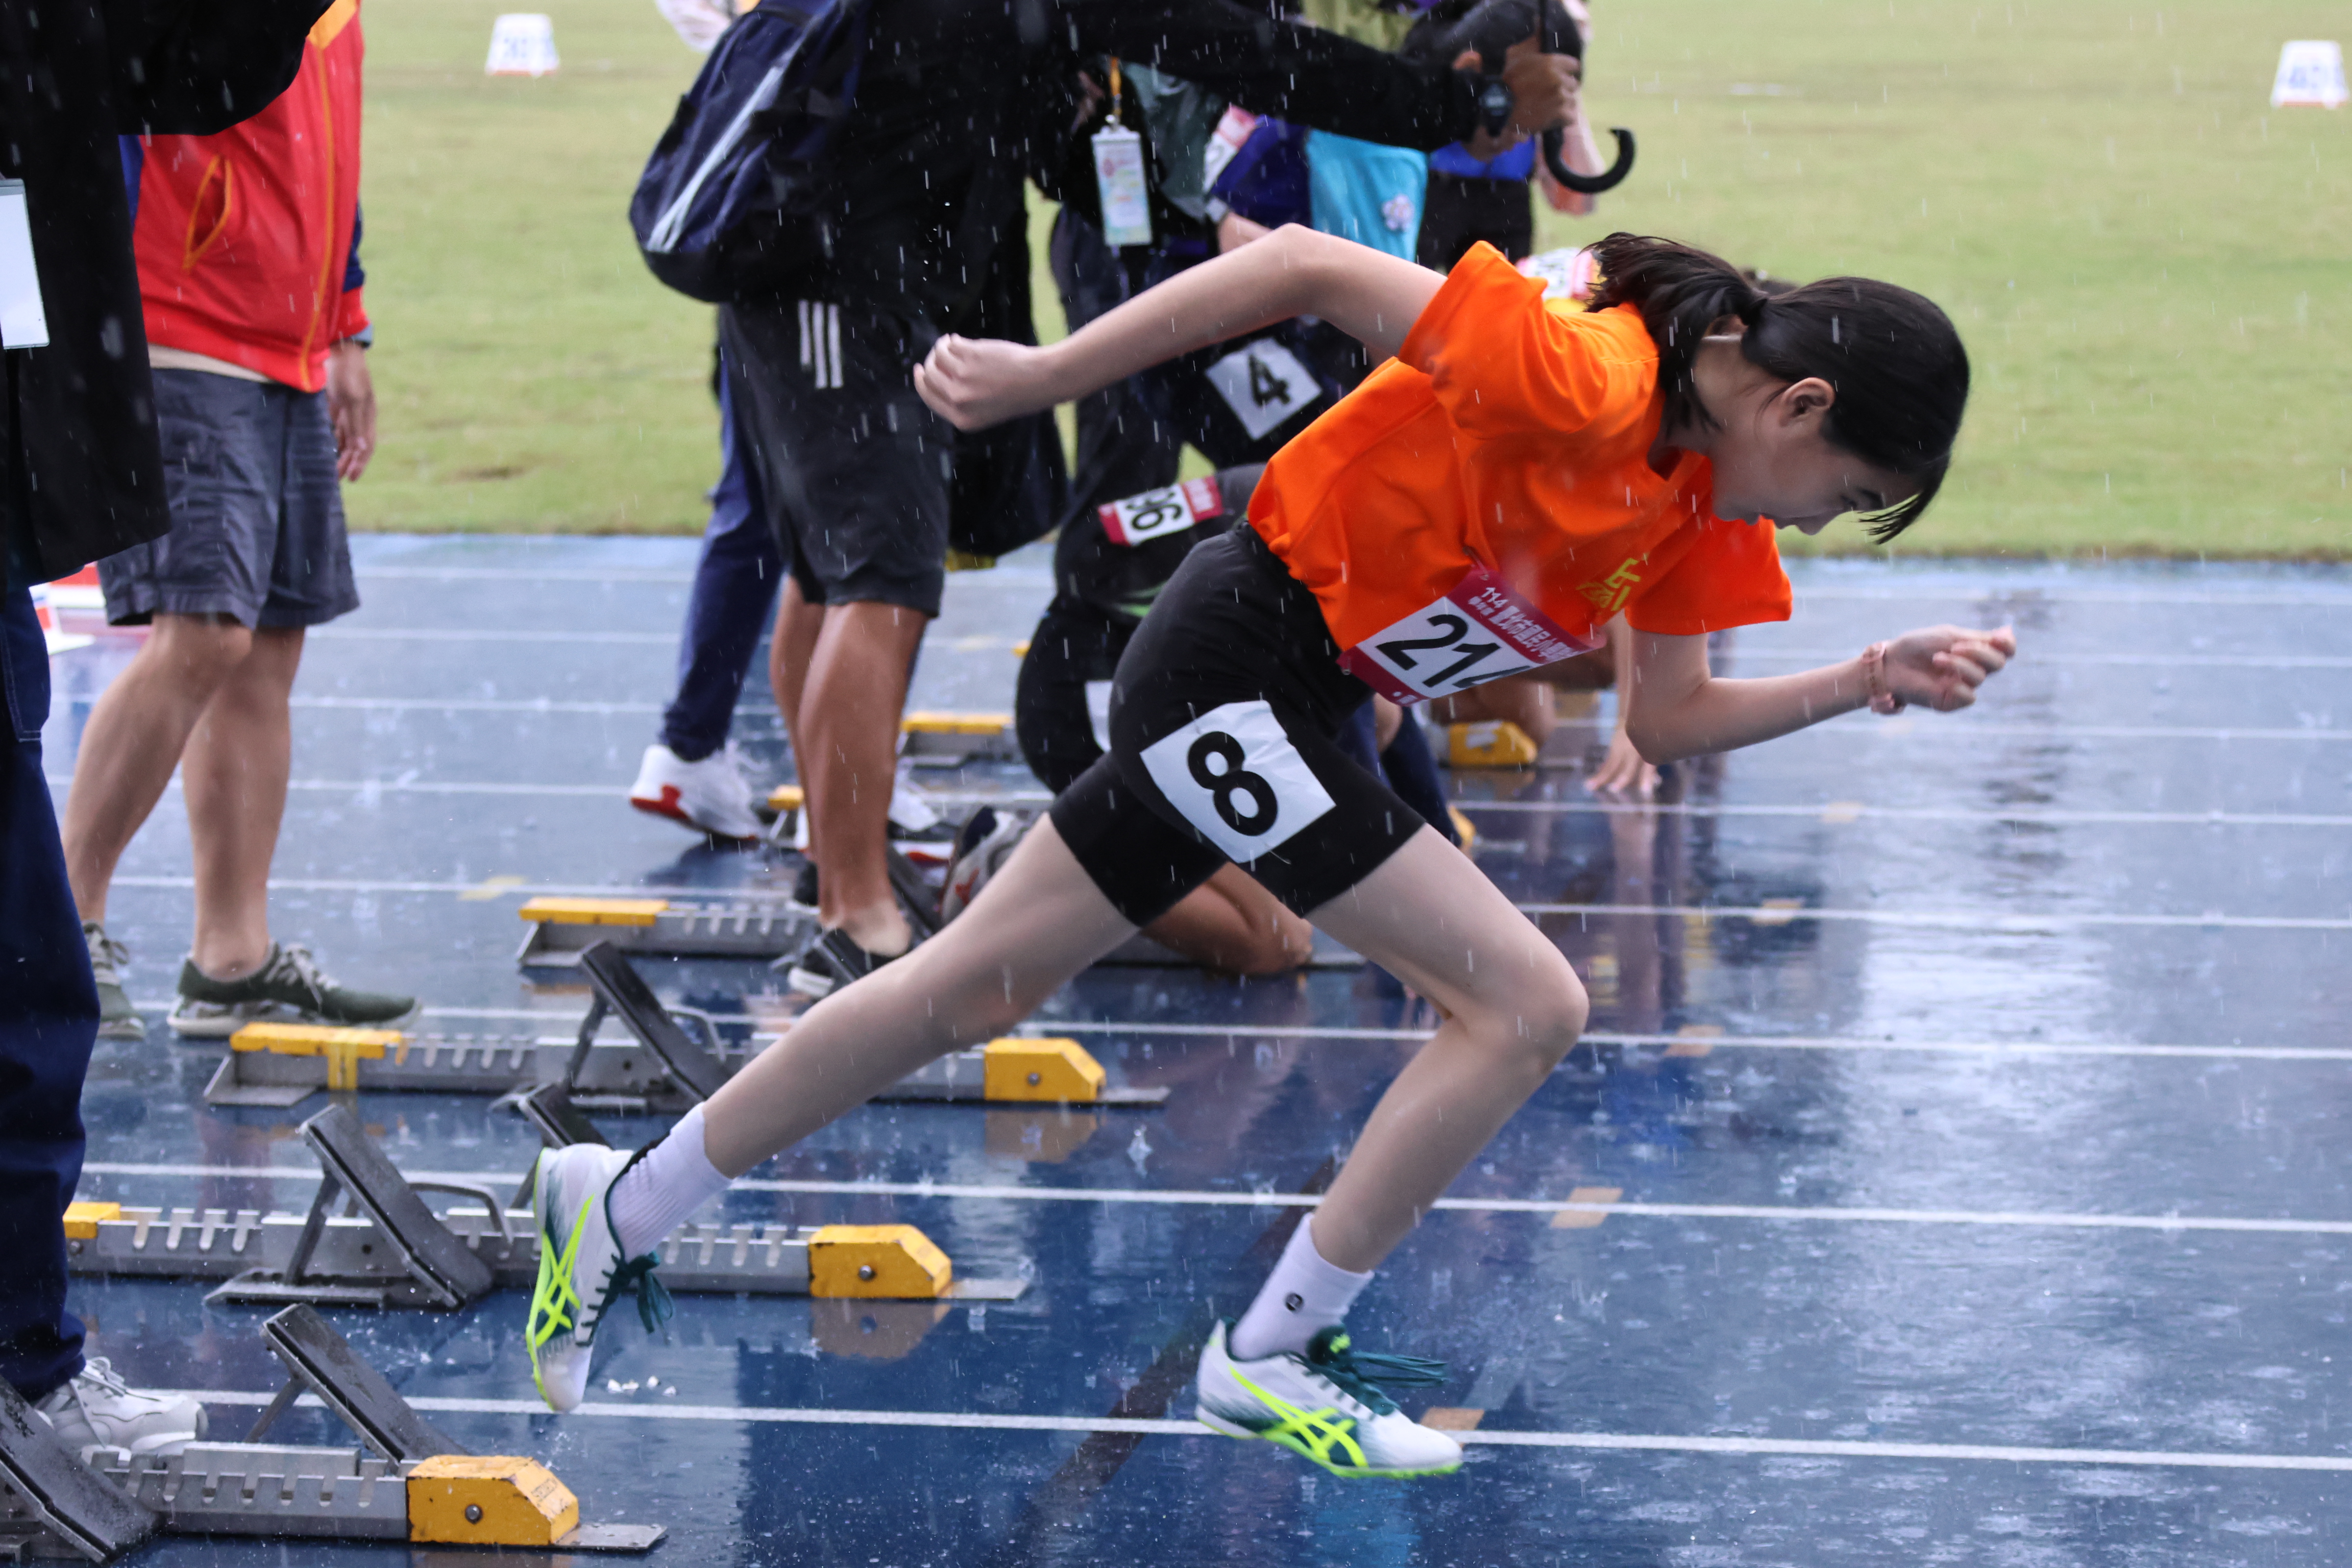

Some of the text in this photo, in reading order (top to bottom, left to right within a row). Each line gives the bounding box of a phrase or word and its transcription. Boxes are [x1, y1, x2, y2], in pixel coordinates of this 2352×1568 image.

[1249, 354, 1292, 408] 4
[1481, 587, 1509, 609] 114
[1186, 731, 1279, 837] 8
